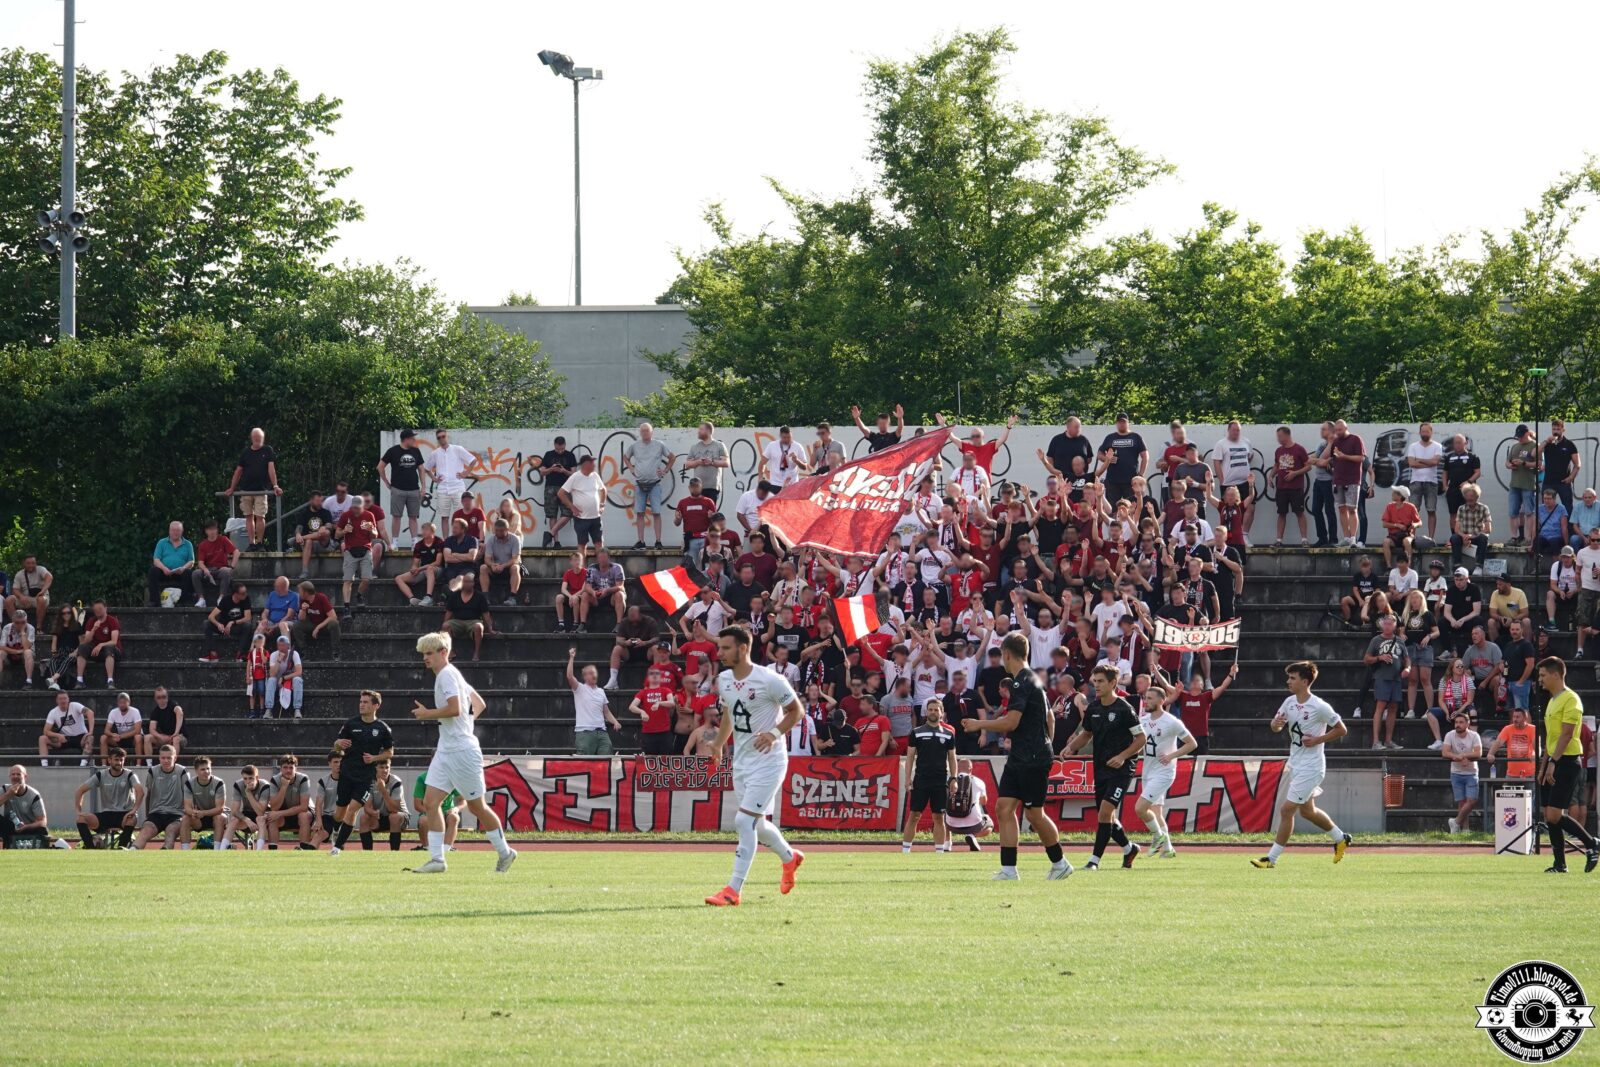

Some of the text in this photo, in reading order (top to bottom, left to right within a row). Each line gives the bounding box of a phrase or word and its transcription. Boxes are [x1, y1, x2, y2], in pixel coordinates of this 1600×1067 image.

[1154, 619, 1181, 645] 19
[1209, 621, 1241, 645] 05
[640, 771, 733, 788] DIFFIDAT
[791, 773, 891, 808] SZENE E
[1113, 787, 1123, 798] 5
[798, 807, 883, 819] REUTLINGEN
